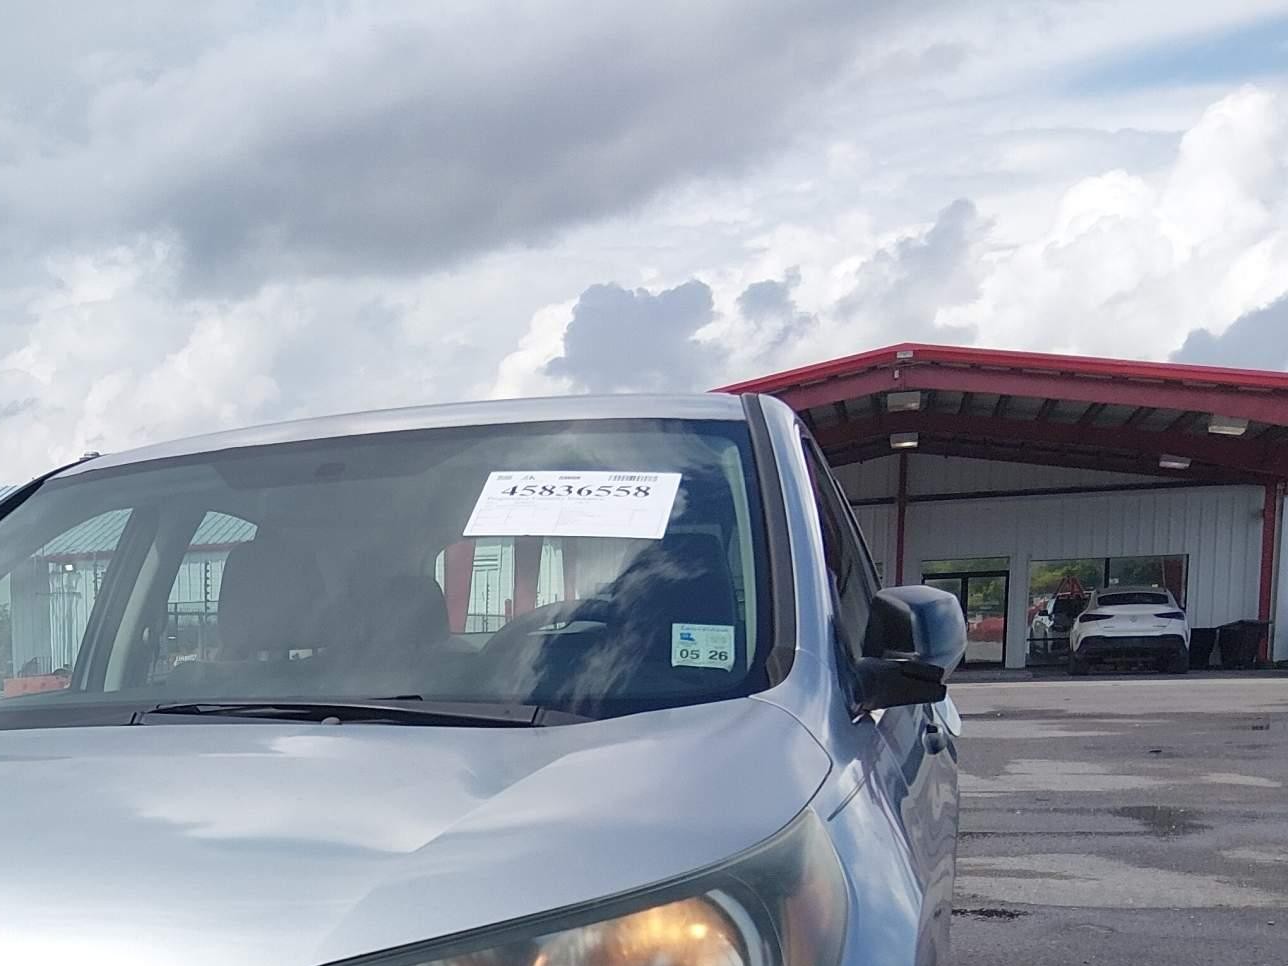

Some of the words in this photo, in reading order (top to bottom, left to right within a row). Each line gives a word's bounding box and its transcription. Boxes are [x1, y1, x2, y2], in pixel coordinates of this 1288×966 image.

[502, 485, 651, 497] 45836558
[680, 649, 700, 660] 05
[708, 650, 728, 661] 26
